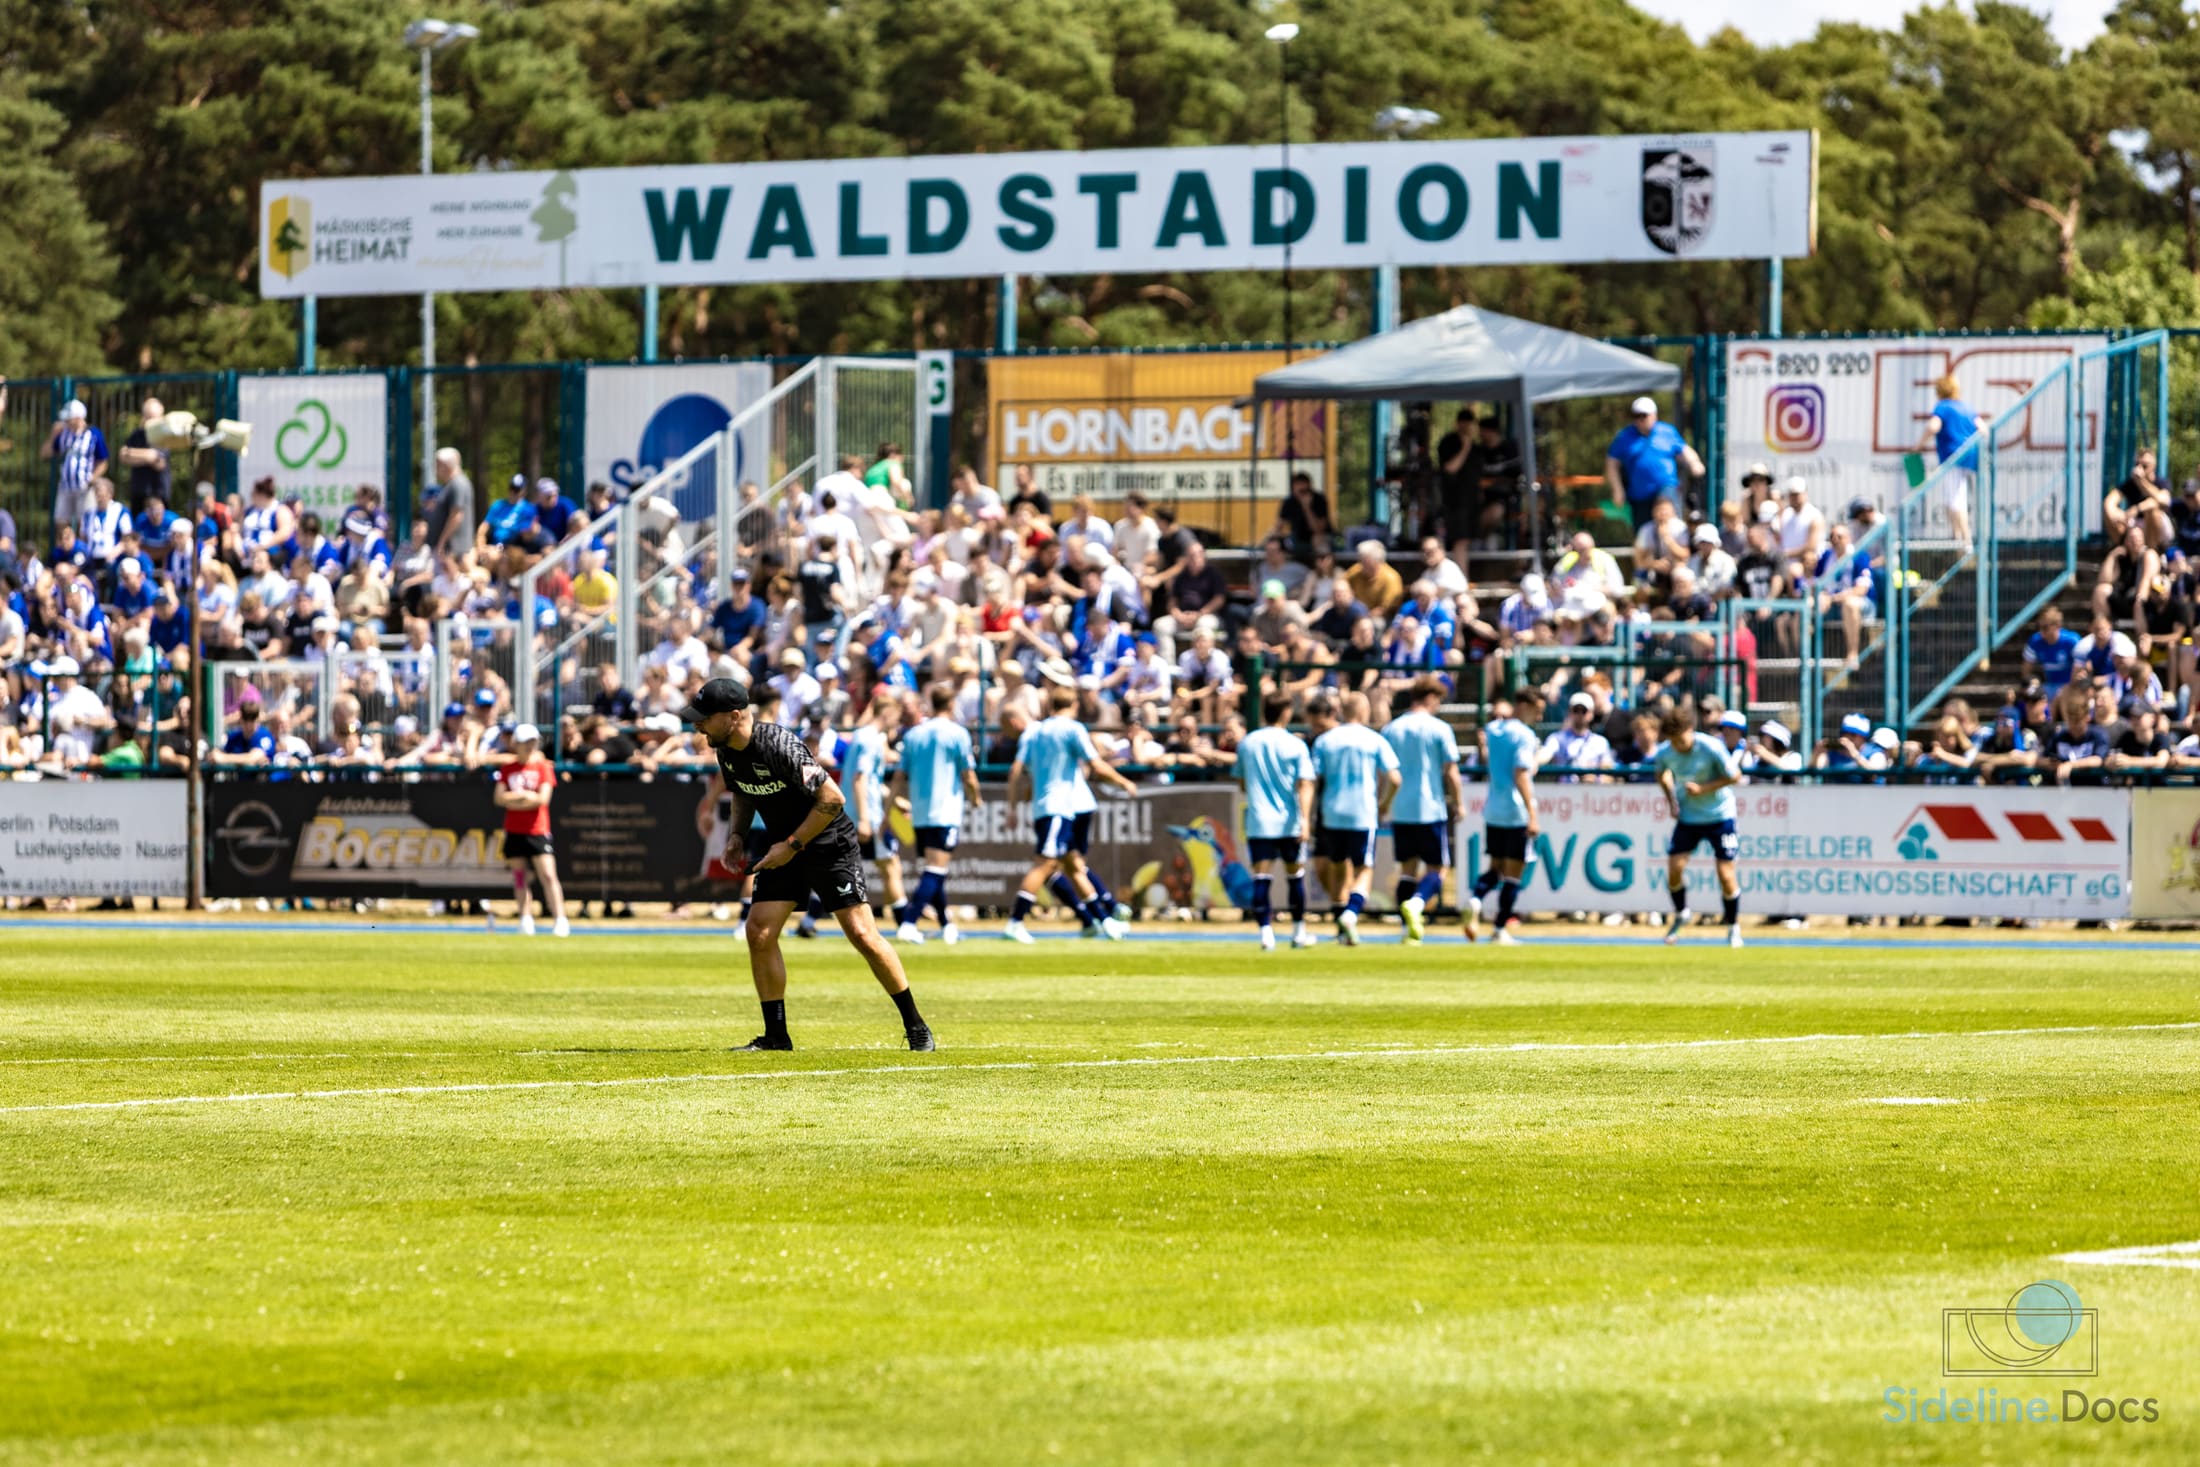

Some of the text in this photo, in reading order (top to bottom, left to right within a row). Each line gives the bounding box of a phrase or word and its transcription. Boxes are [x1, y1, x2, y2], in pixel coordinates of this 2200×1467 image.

[643, 159, 1561, 263] WALDSTADION
[315, 236, 412, 263] HEIMAT
[1777, 353, 1819, 376] 820
[1004, 406, 1267, 457] HORNBACH
[1048, 469, 1065, 490] Es
[1074, 470, 1106, 494] gibt
[1114, 470, 1164, 489] immer
[1175, 470, 1206, 489] was
[318, 796, 412, 812] Autohaus
[0, 812, 120, 834] erlin Potsdam
[15, 840, 121, 863] Ludwigsfelde
[2085, 873, 2121, 899] eG
